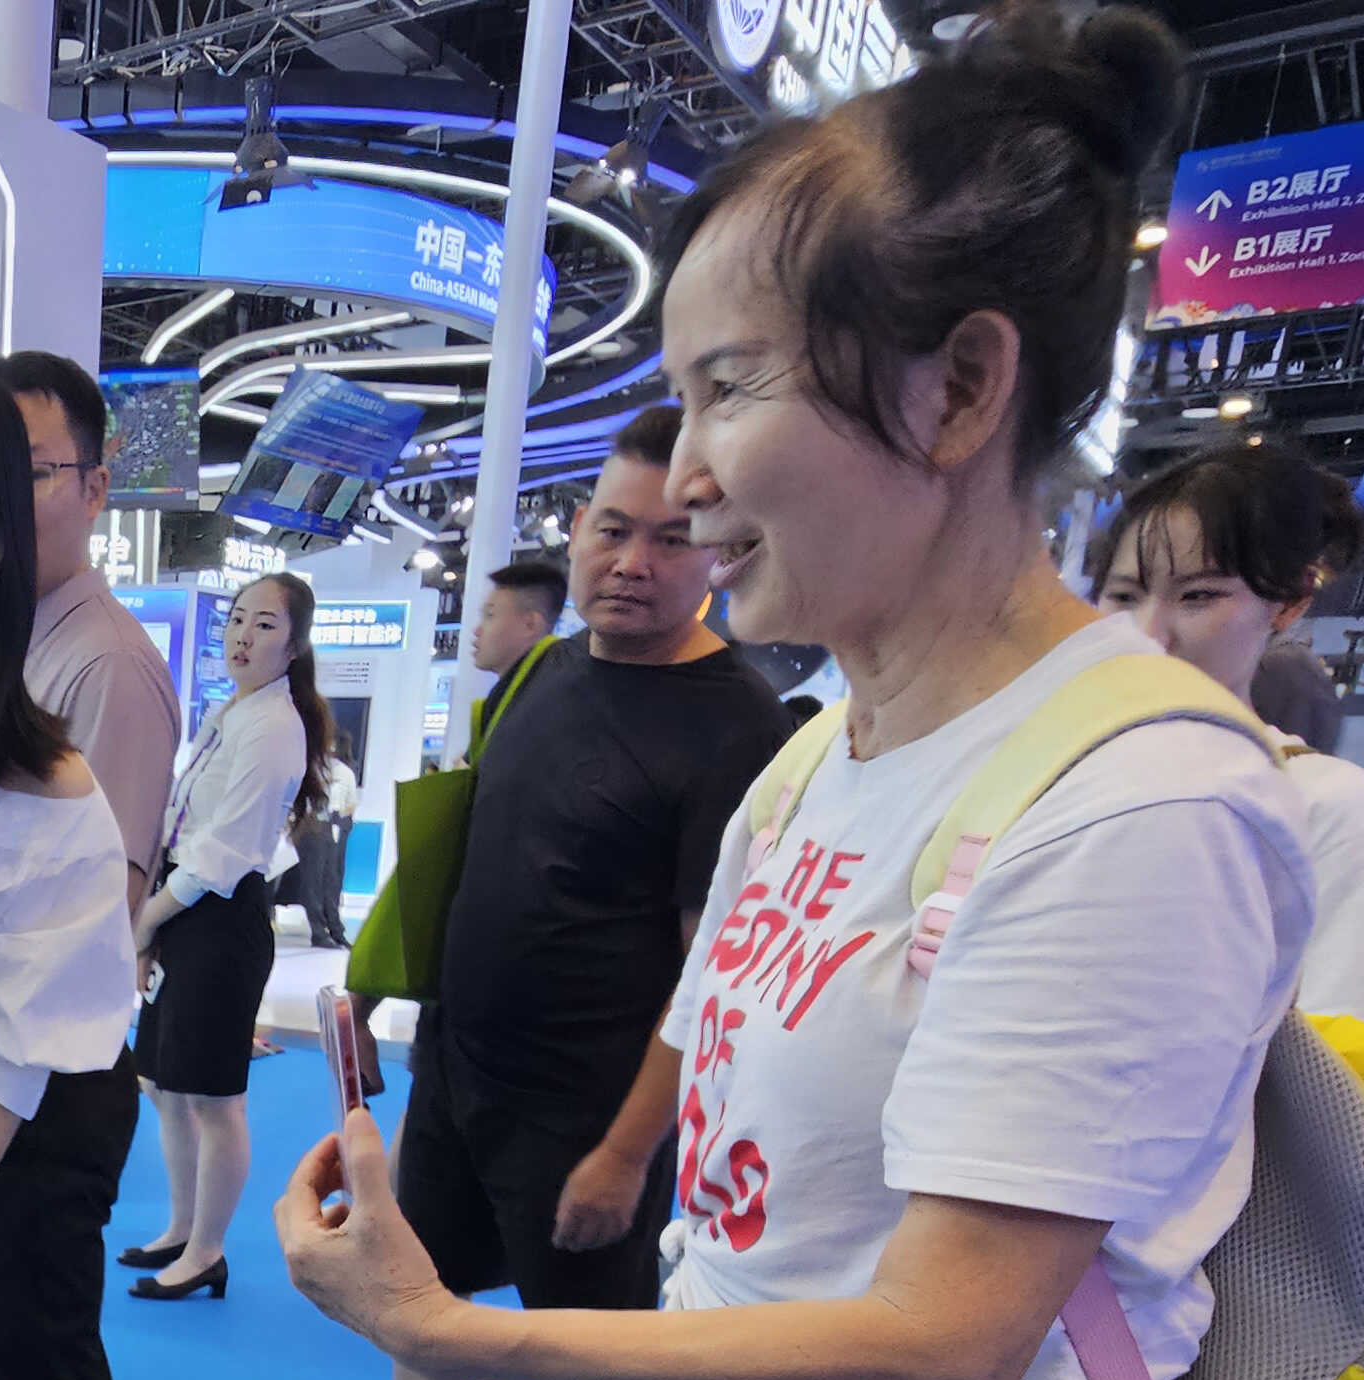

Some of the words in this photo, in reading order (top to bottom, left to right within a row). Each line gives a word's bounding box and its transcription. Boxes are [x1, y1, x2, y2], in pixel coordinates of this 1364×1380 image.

[1246, 165, 1351, 205] B2展厅
[1241, 203, 1309, 222] Exhibition
[1311, 196, 1340, 211] Hall
[1233, 224, 1334, 262] B1展厅
[1228, 263, 1296, 279] Exhibition
[1298, 257, 1327, 270] Hall
[410, 271, 478, 305] China-ASEAN
[695, 995, 746, 1082] OF
